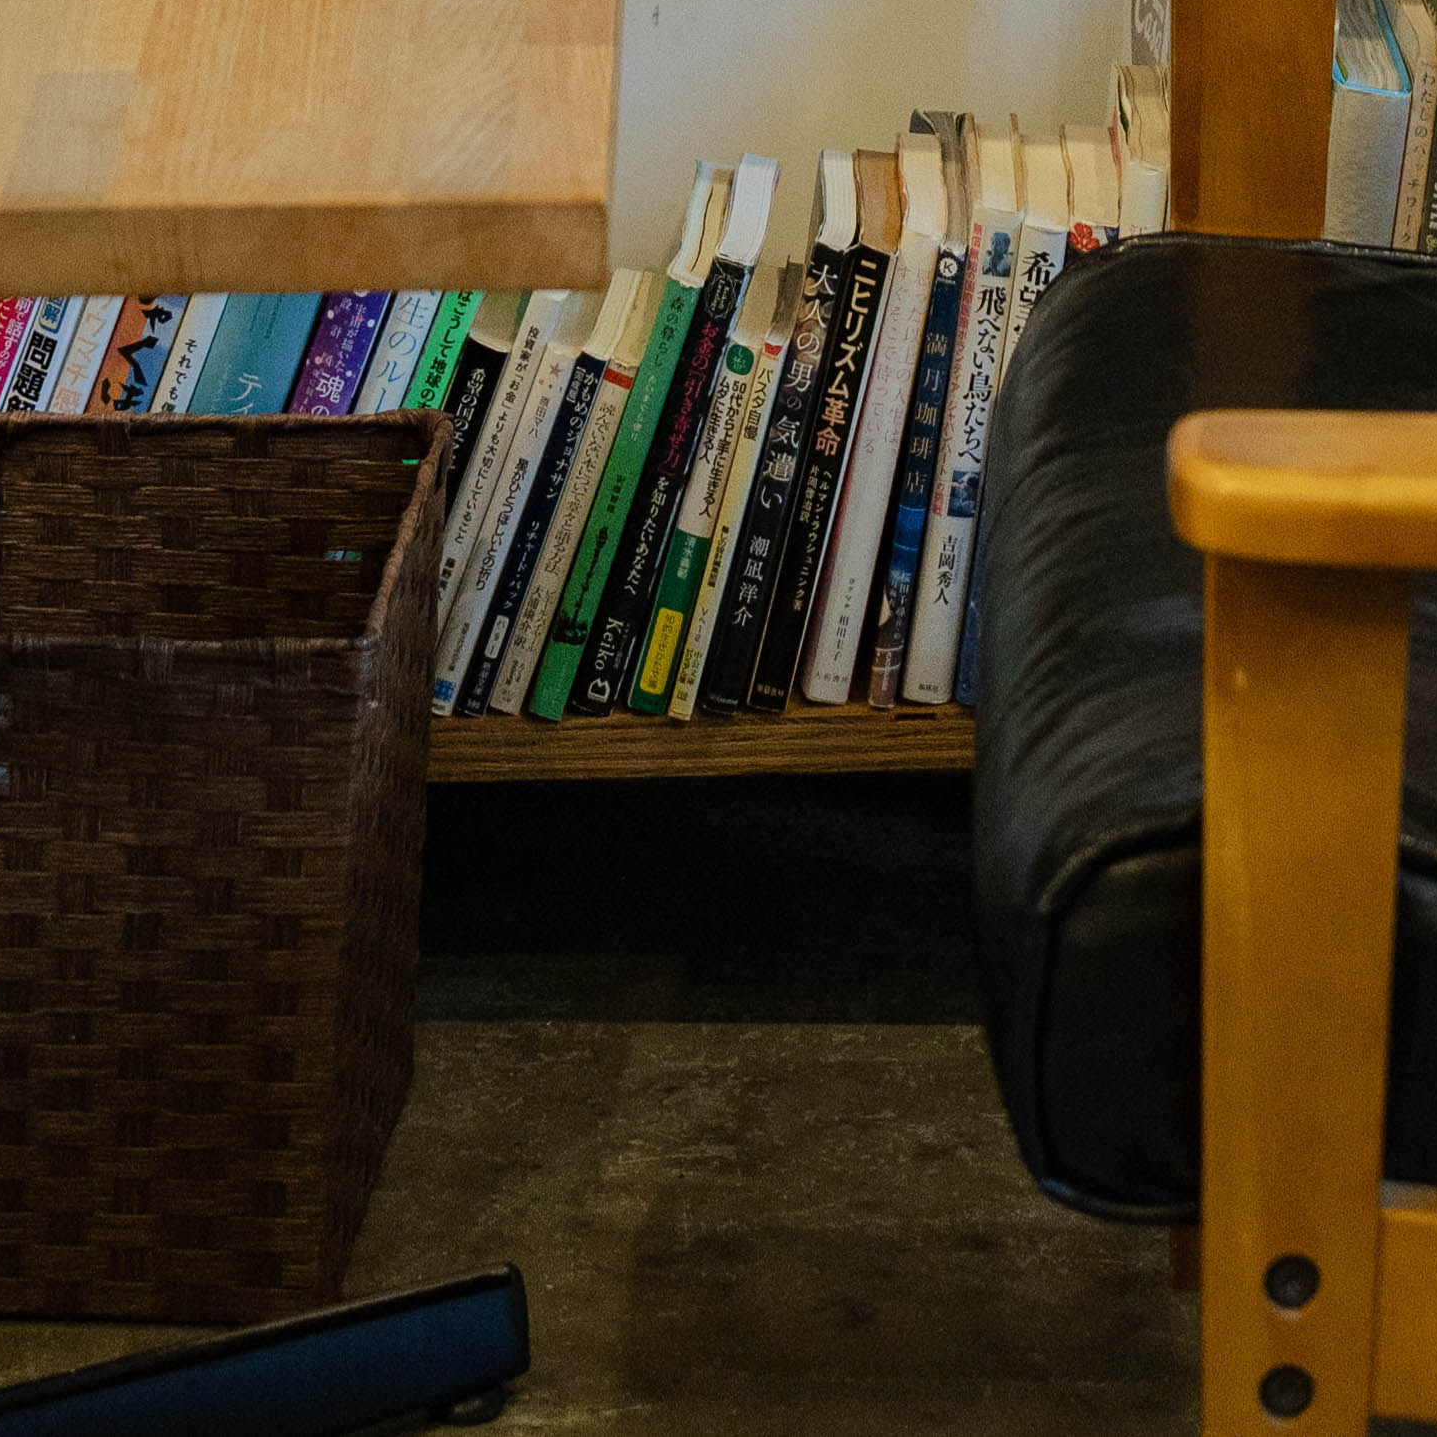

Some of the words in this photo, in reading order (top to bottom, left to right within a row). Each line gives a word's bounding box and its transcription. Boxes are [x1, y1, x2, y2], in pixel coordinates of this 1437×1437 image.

[814, 259, 879, 457] ニヒリズム革命
[957, 285, 1006, 465] 飛べない鳥たちへ
